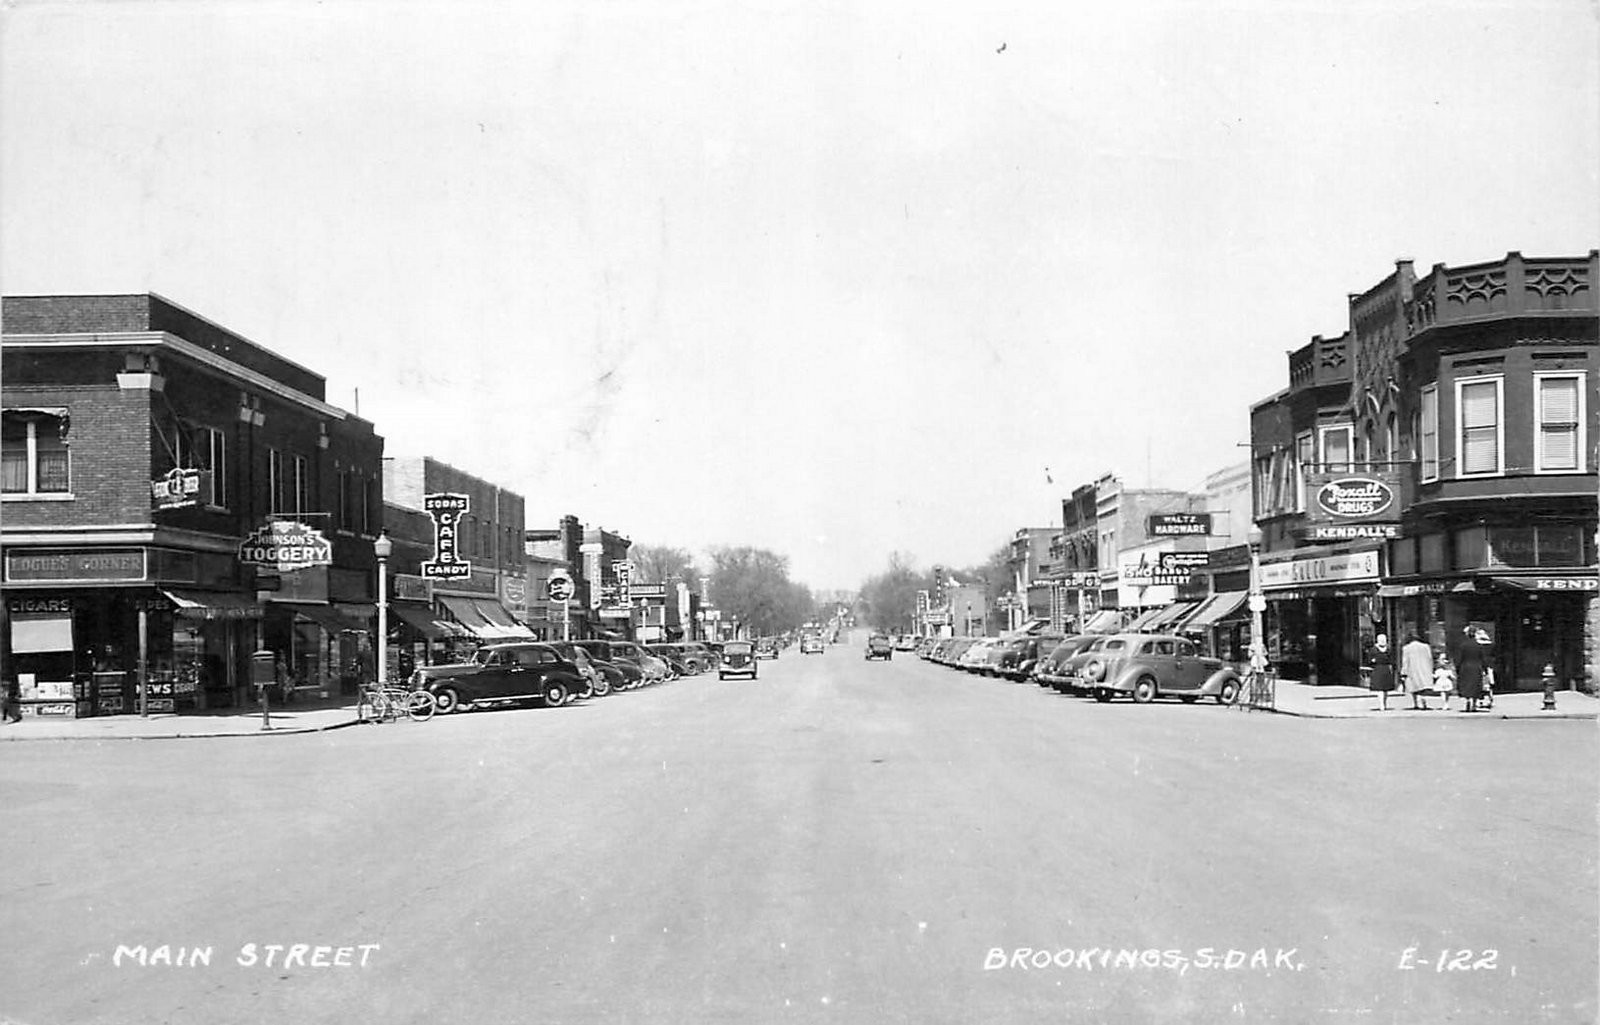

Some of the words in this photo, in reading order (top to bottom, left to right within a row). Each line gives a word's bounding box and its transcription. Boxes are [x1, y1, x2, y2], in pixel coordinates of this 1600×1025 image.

[427, 499, 465, 509] SODAS
[1337, 501, 1375, 513] DRUGS
[1163, 515, 1197, 523] WALTZ
[1155, 524, 1206, 534] HARDWARE
[1316, 526, 1396, 538] KENDALL'S
[254, 533, 315, 545] JOHNSON'S
[440, 512, 453, 563] CAFE
[243, 546, 328, 561] TOGGERY
[80, 556, 141, 571] CORNER
[426, 566, 467, 575] CANDY
[1154, 575, 1191, 585] BAKERY
[1537, 580, 1598, 590] KEND
[10, 599, 70, 612] CIGARS
